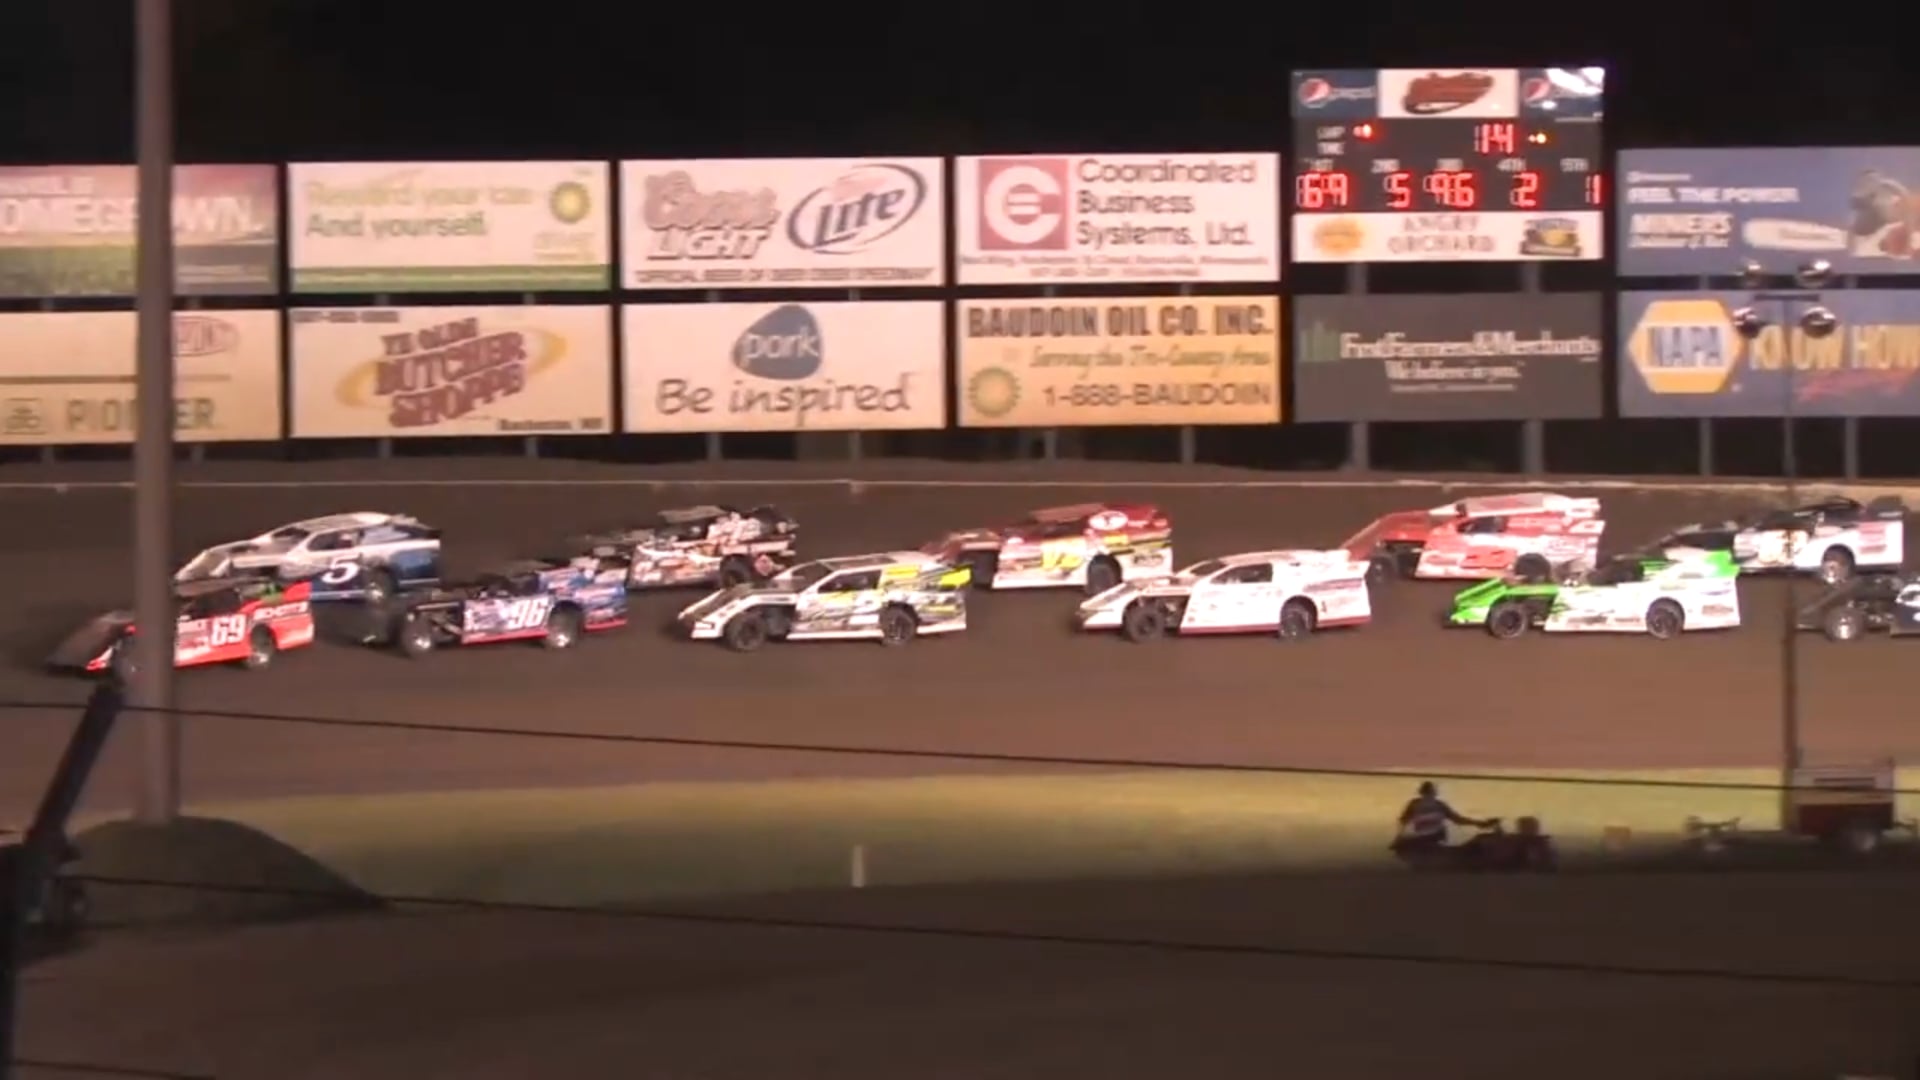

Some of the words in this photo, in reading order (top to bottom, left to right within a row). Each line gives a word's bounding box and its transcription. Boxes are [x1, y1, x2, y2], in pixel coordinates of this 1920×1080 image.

[1480, 123, 1514, 153] 14
[1076, 158, 1257, 184] Coordinated
[1076, 190, 1195, 214] Business
[1301, 173, 1347, 207] 69
[1389, 173, 1410, 208] 5
[1429, 173, 1474, 207] 96
[1514, 172, 1538, 207] 2
[305, 213, 363, 237] And
[813, 188, 906, 248] Lite
[968, 306, 1099, 338] BAUDOIN
[1107, 306, 1151, 337] OIL
[1159, 305, 1207, 336] CO.
[1214, 305, 1274, 336] INC.
[741, 325, 819, 369] park
[1647, 326, 1724, 367] NAPA
[374, 331, 527, 397] BUTCHER
[388, 362, 526, 429] SHOPPE
[654, 377, 714, 416] Be
[728, 371, 912, 428] inspired
[1042, 382, 1271, 407] 1-888-BAUDOIN
[321, 553, 359, 584] 5
[508, 596, 551, 627] 96
[211, 613, 246, 646] 69
